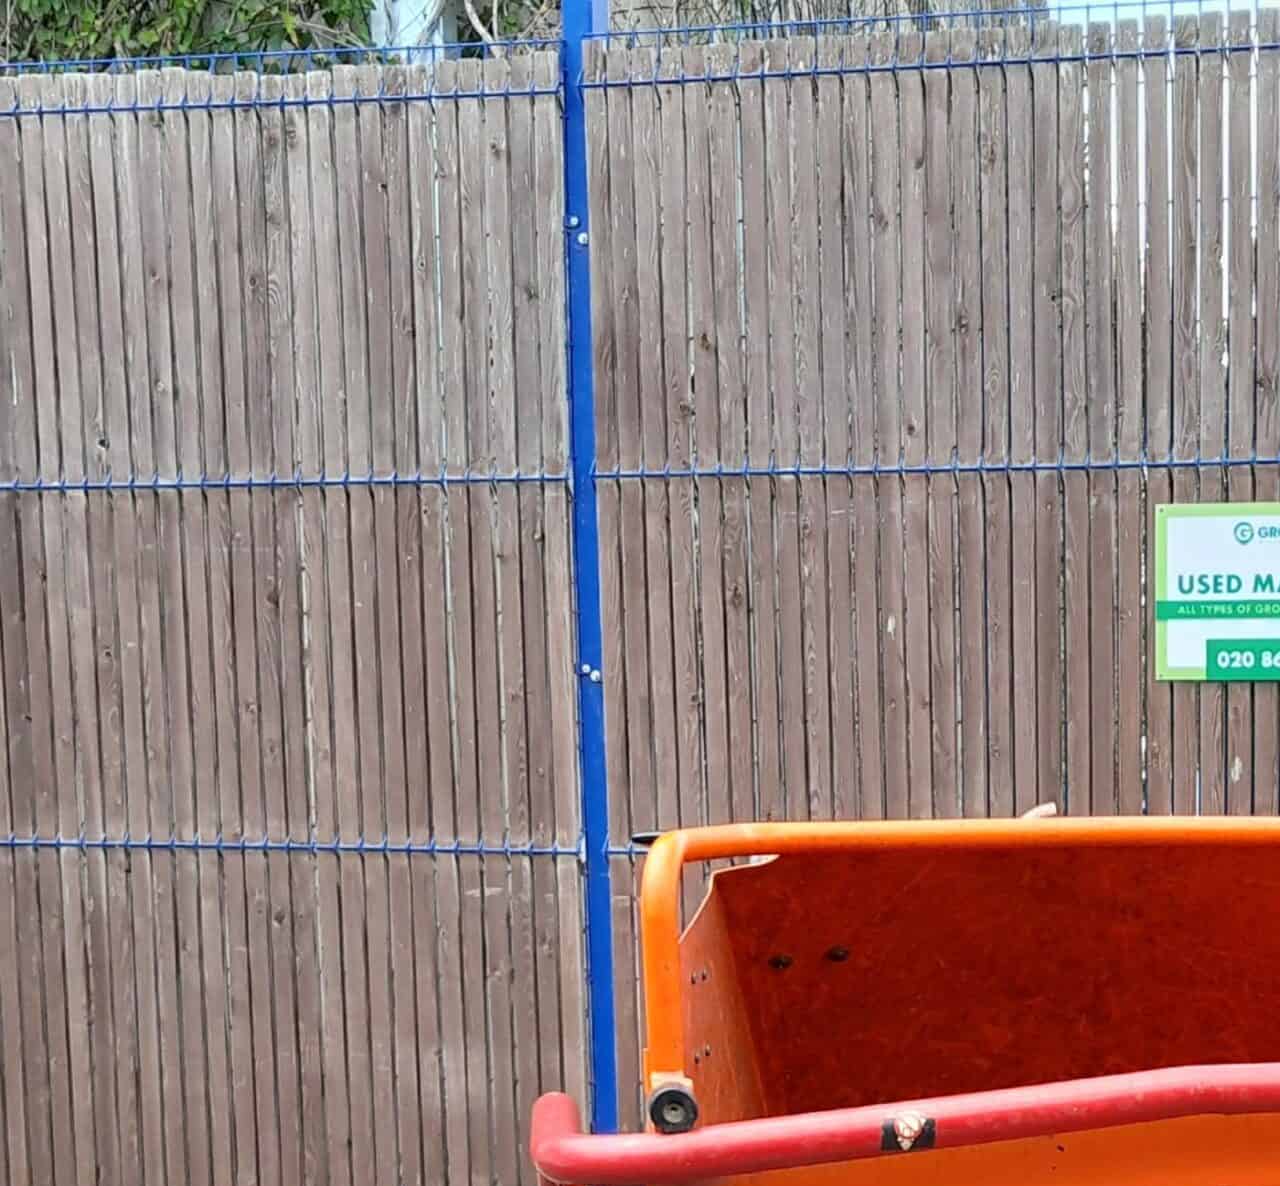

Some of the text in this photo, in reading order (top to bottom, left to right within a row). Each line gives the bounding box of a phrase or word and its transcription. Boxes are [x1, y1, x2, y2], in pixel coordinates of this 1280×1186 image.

[1177, 574, 1243, 595] USED
[1177, 605, 1196, 615] ALL
[1200, 604, 1233, 615] TYPES
[1237, 603, 1250, 614] OF
[1217, 650, 1255, 668] 020
